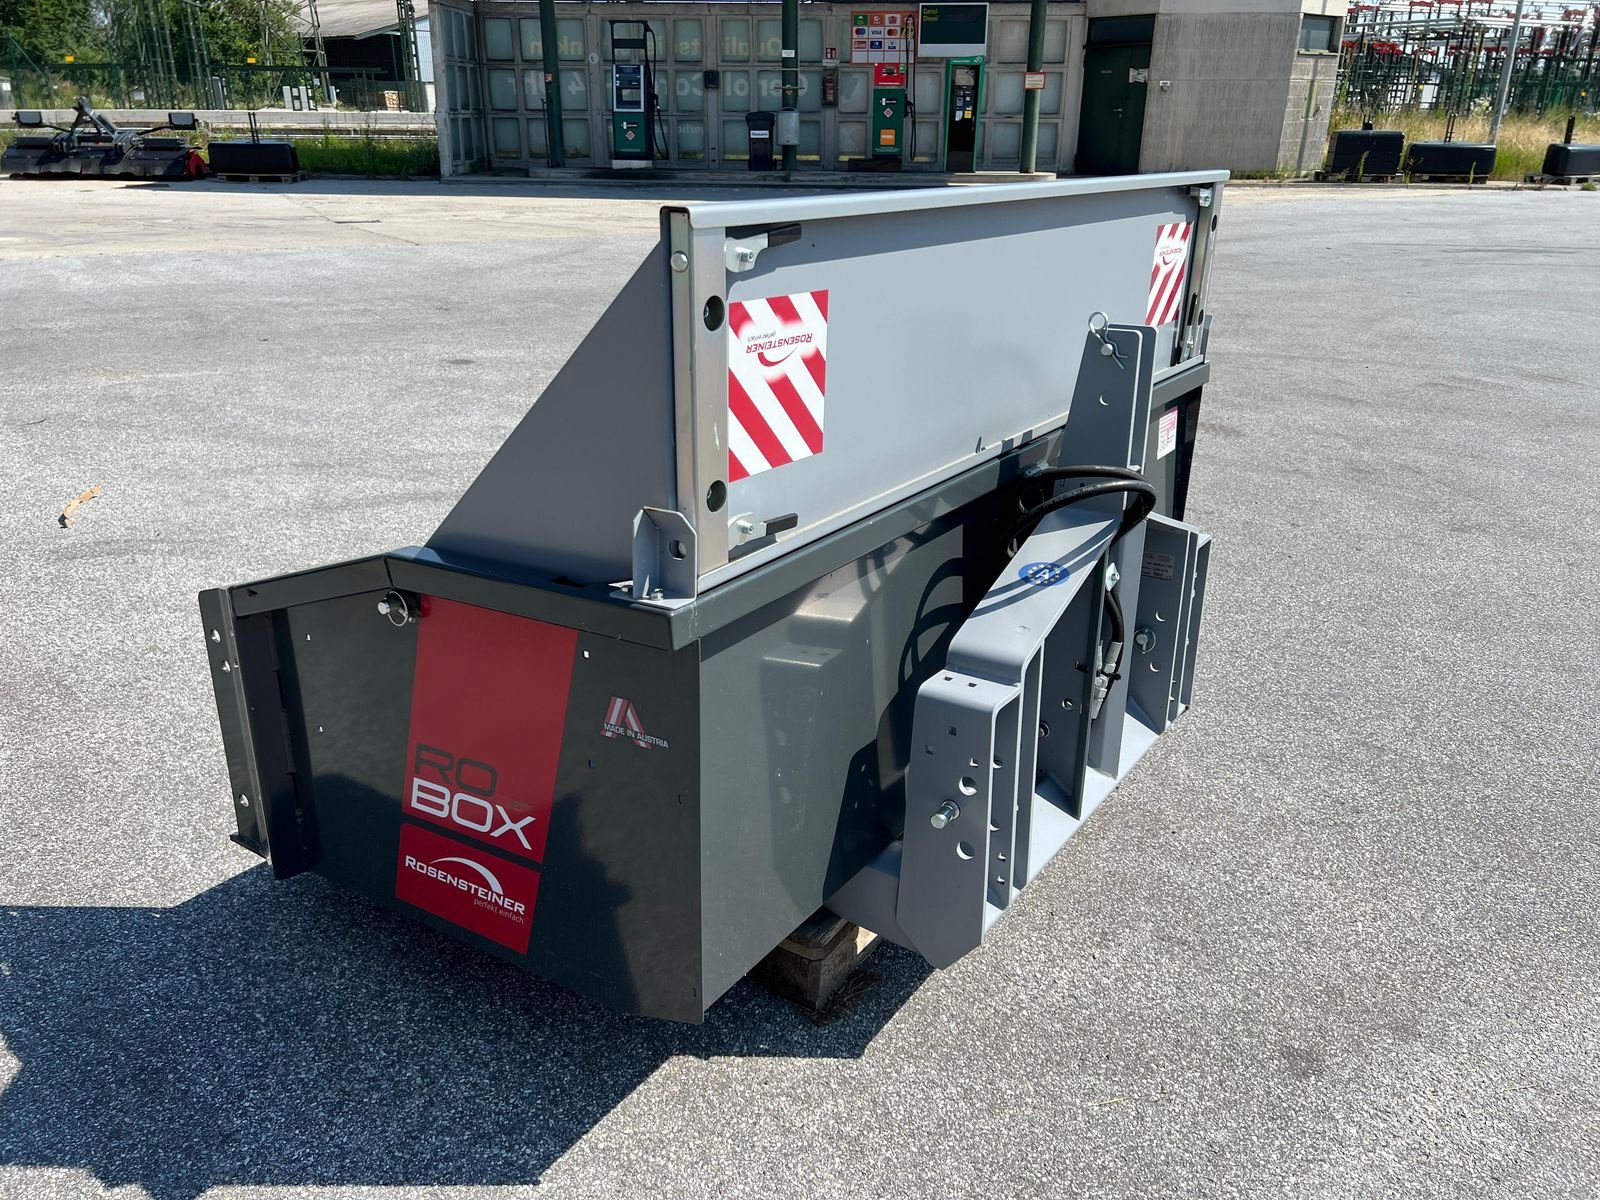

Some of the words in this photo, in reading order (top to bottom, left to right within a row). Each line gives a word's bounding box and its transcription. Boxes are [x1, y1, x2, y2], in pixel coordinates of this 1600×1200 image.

[746, 333, 813, 354] ROSENSTEINER
[1037, 569, 1050, 580] A
[603, 722, 625, 736] MADE
[626, 729, 636, 738] IN
[636, 733, 669, 749] AUSTRIA
[415, 744, 498, 797] RO
[411, 776, 537, 851] BOX
[405, 855, 525, 916] ROSENSTEINER
[473, 898, 498, 914] perfekt
